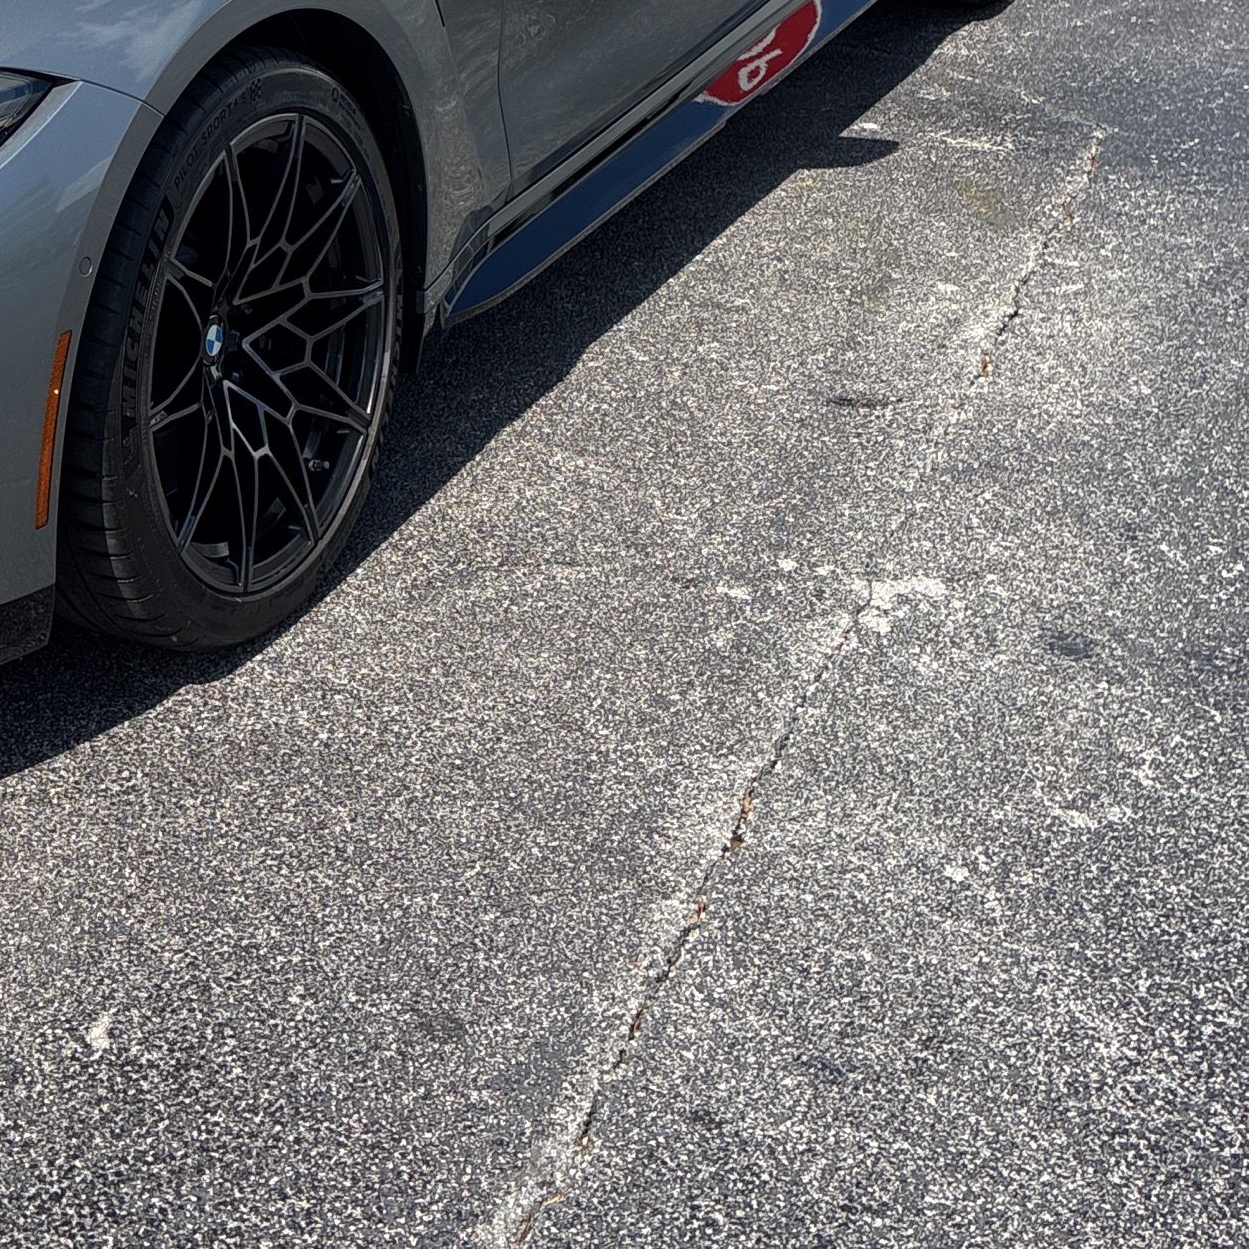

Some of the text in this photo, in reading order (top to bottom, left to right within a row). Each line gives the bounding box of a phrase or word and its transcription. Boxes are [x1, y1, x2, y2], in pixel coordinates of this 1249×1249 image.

[173, 144, 199, 190] PILOT
[201, 102, 232, 146] SPORT
[122, 209, 170, 425] MICHELIN
